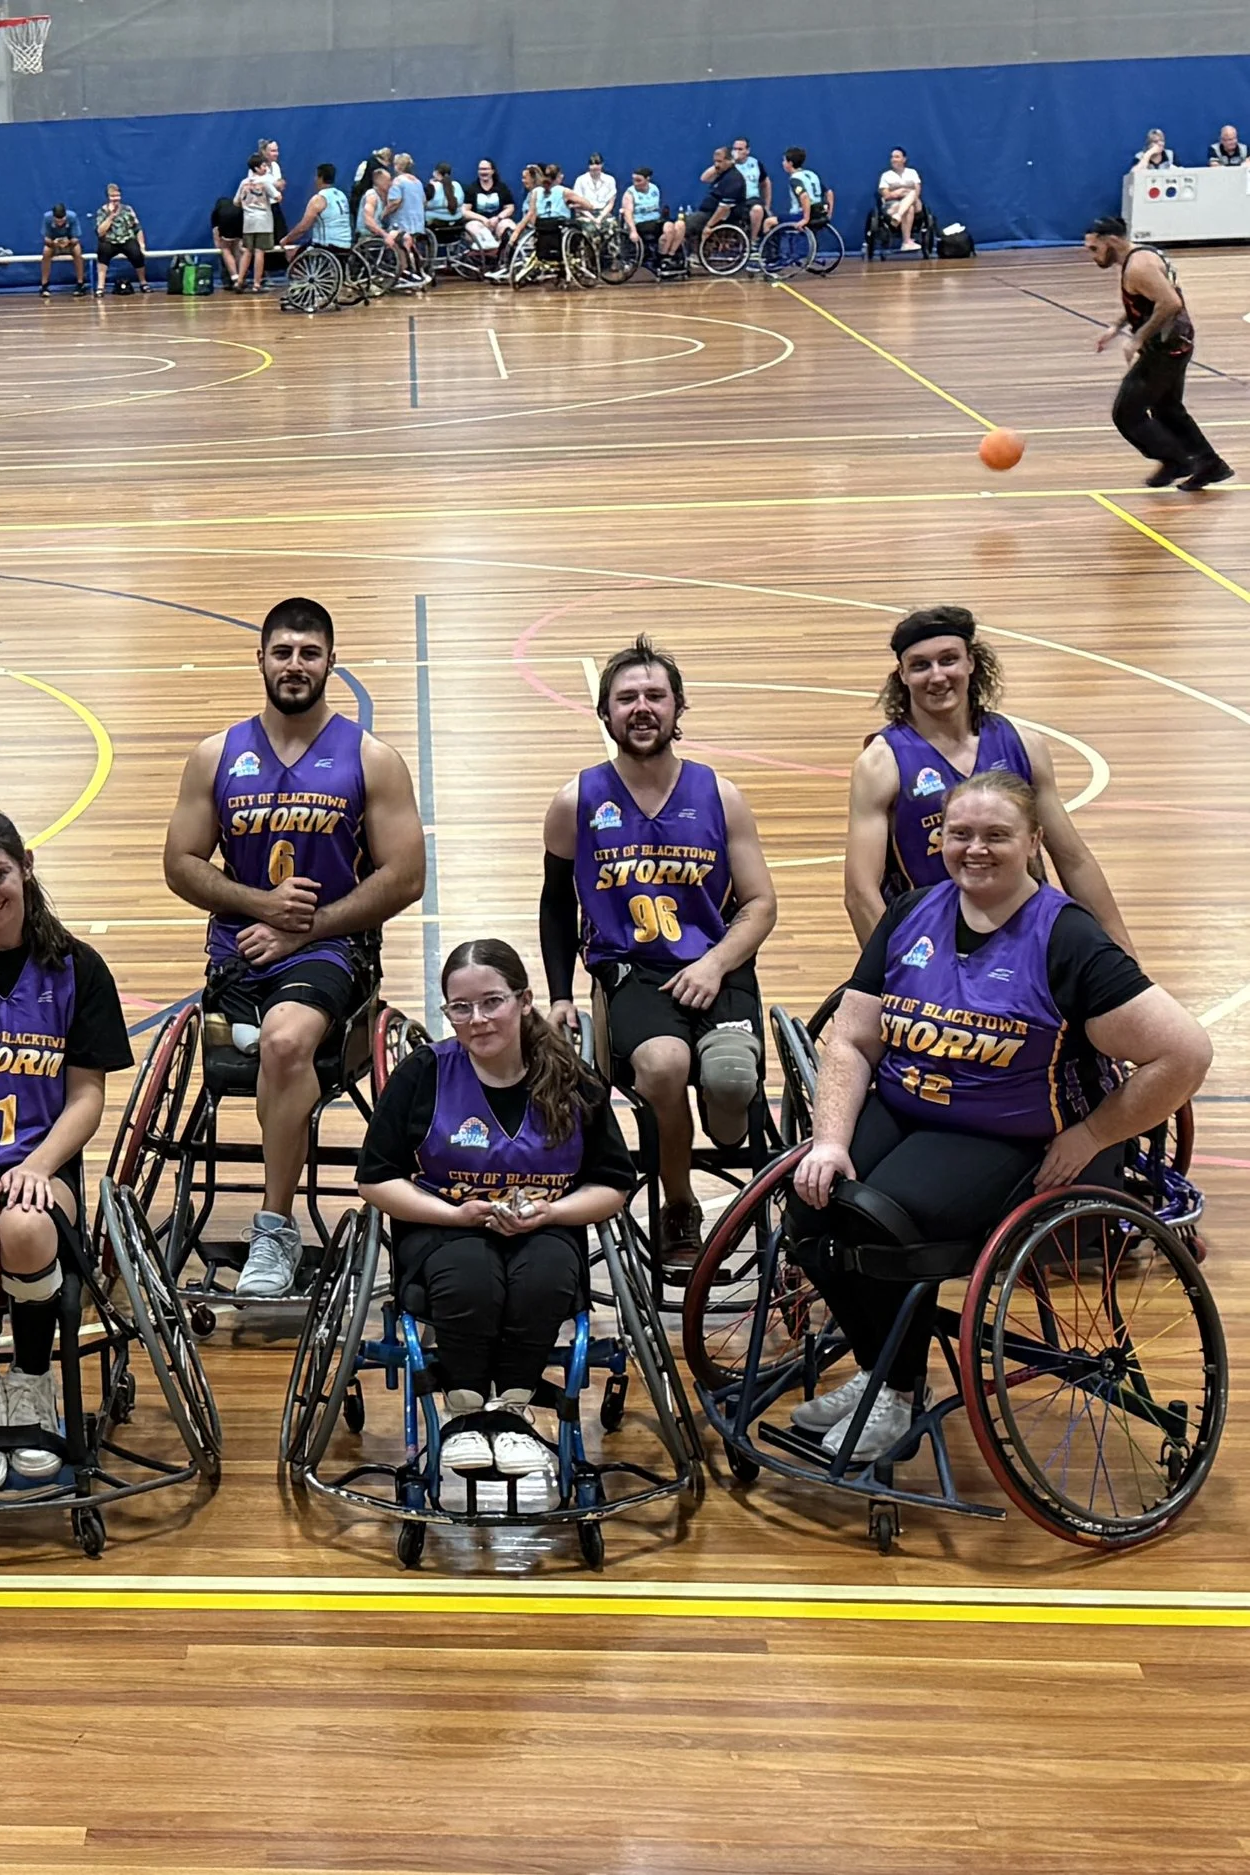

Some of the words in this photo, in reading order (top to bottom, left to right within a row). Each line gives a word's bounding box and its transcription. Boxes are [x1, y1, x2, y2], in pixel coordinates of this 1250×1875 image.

[228, 794, 255, 809] CITY
[258, 792, 275, 805] OF
[277, 792, 347, 809] BLACKTOWN
[230, 806, 344, 836] STORM
[268, 839, 295, 886] 6
[594, 847, 621, 861] CITY
[623, 844, 638, 857] OF
[641, 844, 717, 862] BLACKTOWN
[595, 859, 714, 890] STORM
[628, 894, 682, 943] 96
[901, 998, 920, 1013] OF
[921, 1002, 1029, 1035] BLACKTOWN
[449, 1170, 480, 1182] CITY
[483, 1173, 500, 1185] OF
[505, 1172, 576, 1187] BLACKTO
